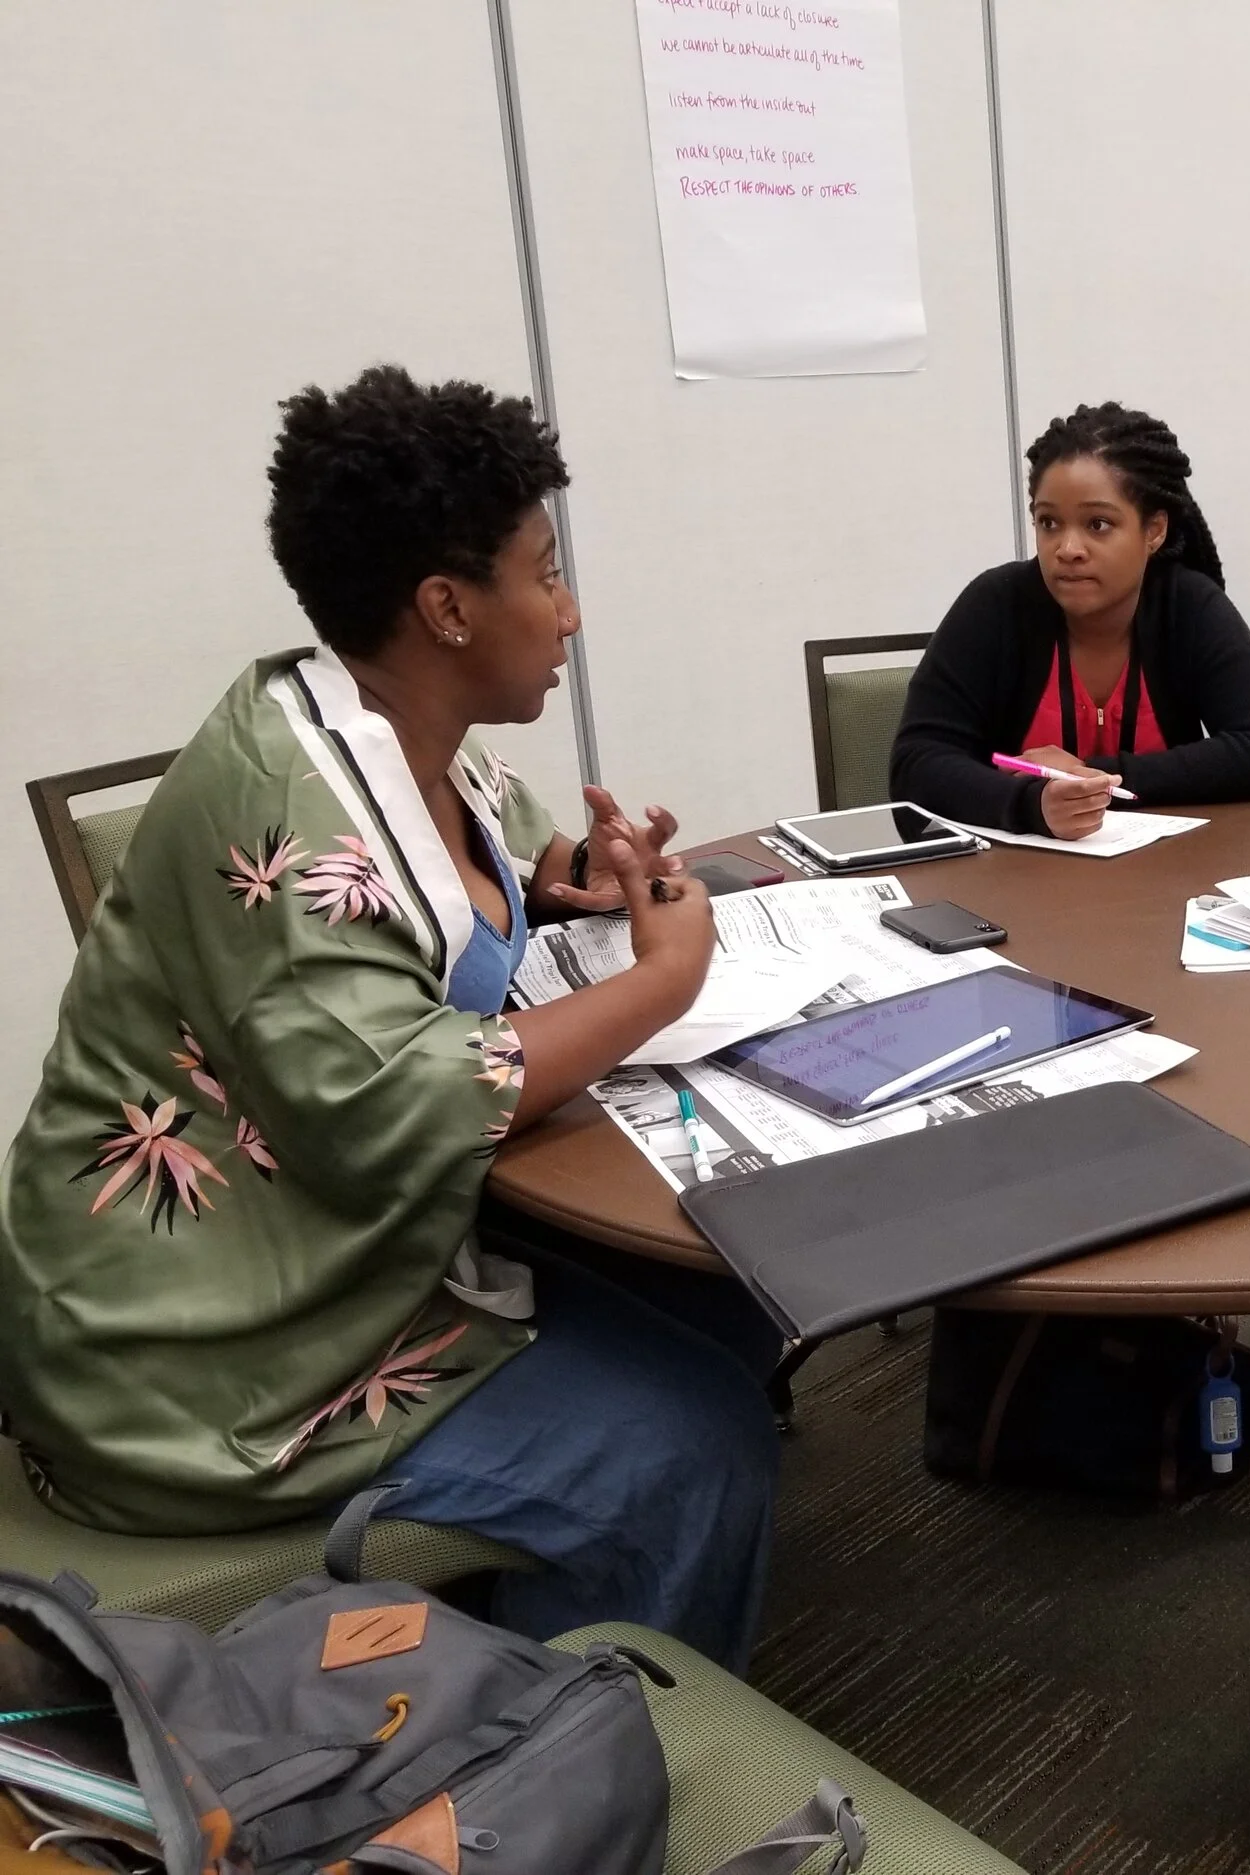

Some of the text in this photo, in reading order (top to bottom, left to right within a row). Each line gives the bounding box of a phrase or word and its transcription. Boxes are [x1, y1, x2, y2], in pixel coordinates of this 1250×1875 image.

[707, 0, 741, 19] accept
[746, 3, 752, 14] a
[757, 1, 780, 18] lack
[783, 6, 796, 30] of
[798, 8, 840, 29] closure
[660, 38, 865, 71] we cannot be articulate all of the time
[669, 91, 816, 117] listen from the inside out
[675, 144, 815, 170] make space, take space
[680, 176, 731, 199] RESPECT
[734, 180, 752, 195] THE
[755, 182, 796, 197] OPINIONS
[801, 185, 814, 197] OF
